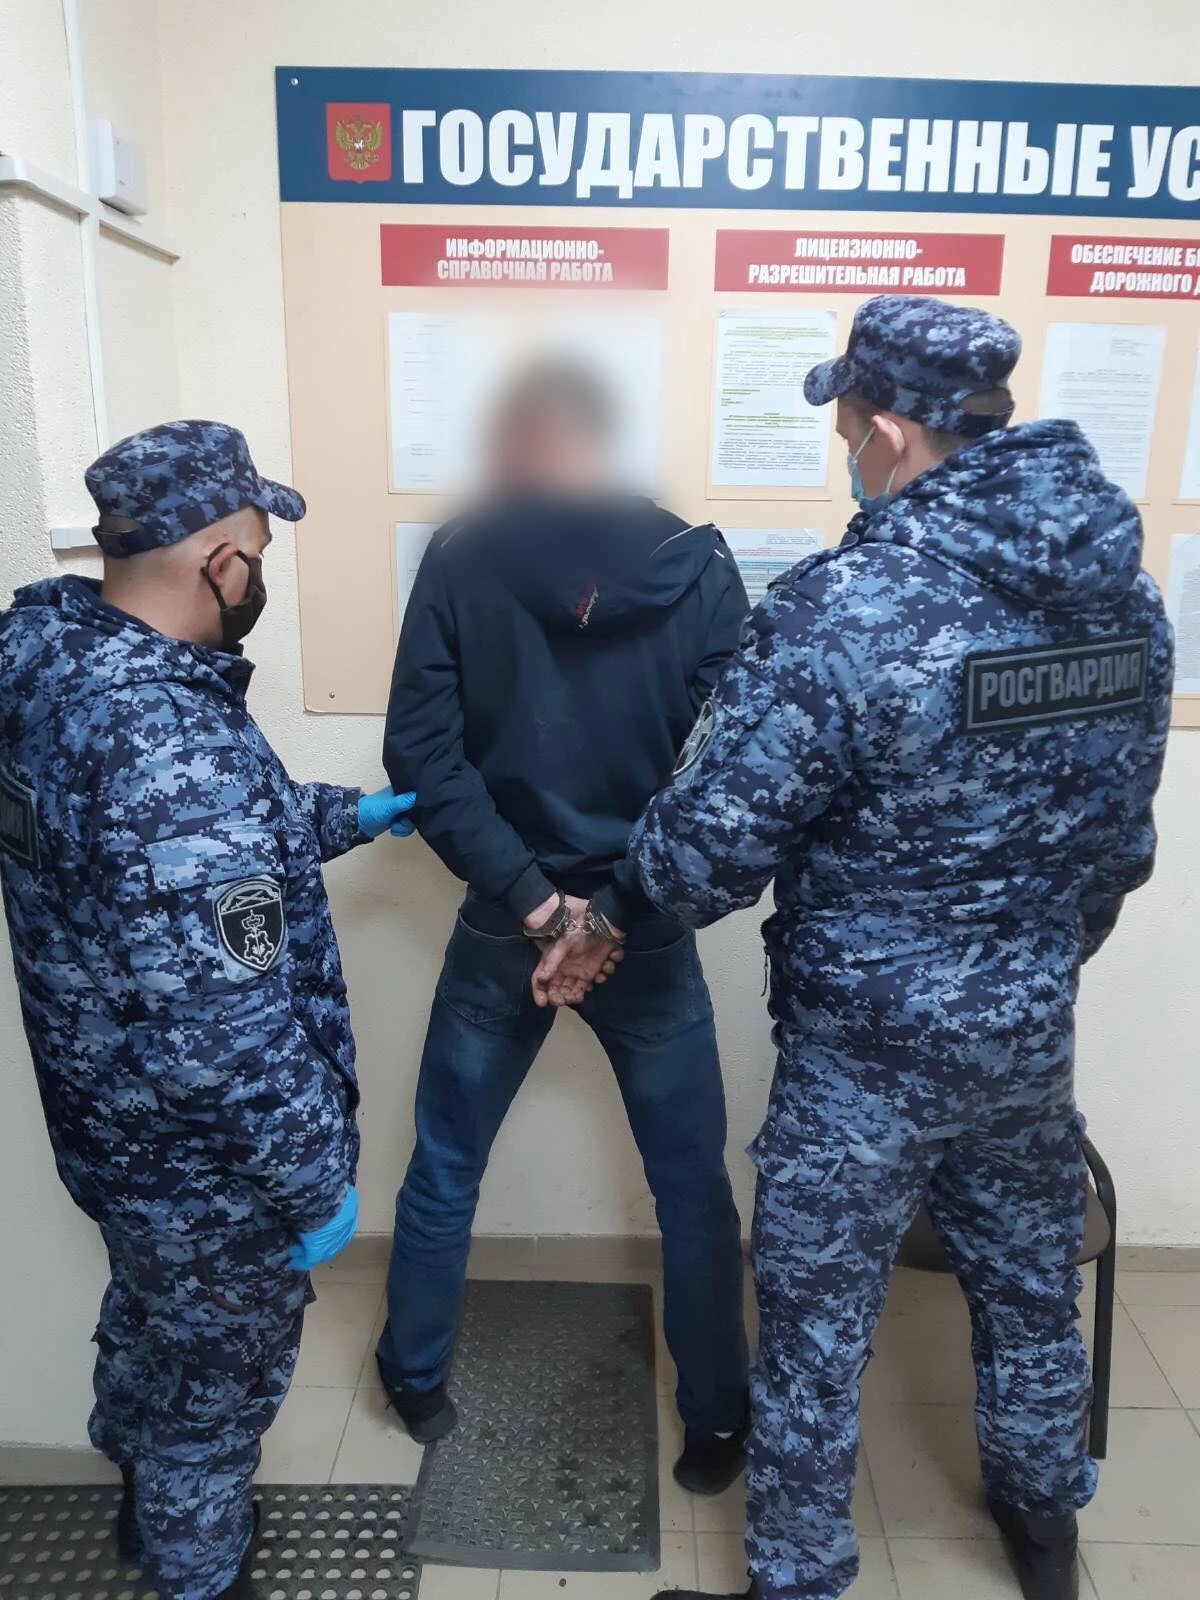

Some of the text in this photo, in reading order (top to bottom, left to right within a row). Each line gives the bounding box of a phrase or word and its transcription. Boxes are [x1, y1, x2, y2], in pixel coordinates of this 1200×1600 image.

[402, 108, 1115, 199] ГОСУДАРСТВЕННЫЕ
[445, 238, 604, 261] ИНФОРМАЦИОННО-
[794, 238, 923, 260] ЛИЦЕНЗИОННО-
[1071, 243, 1183, 266] ОБЕСПЕЧЕНИЕ
[437, 260, 613, 282] СПРАВОЧНАЯ РАБОТА
[748, 264, 966, 287] РАЗРЕШИТЕЛЬНАЯ РАБОТА
[1089, 271, 1192, 293] ДОРОЖНОГО
[980, 651, 1142, 711] РОСГВАРДИЯ
